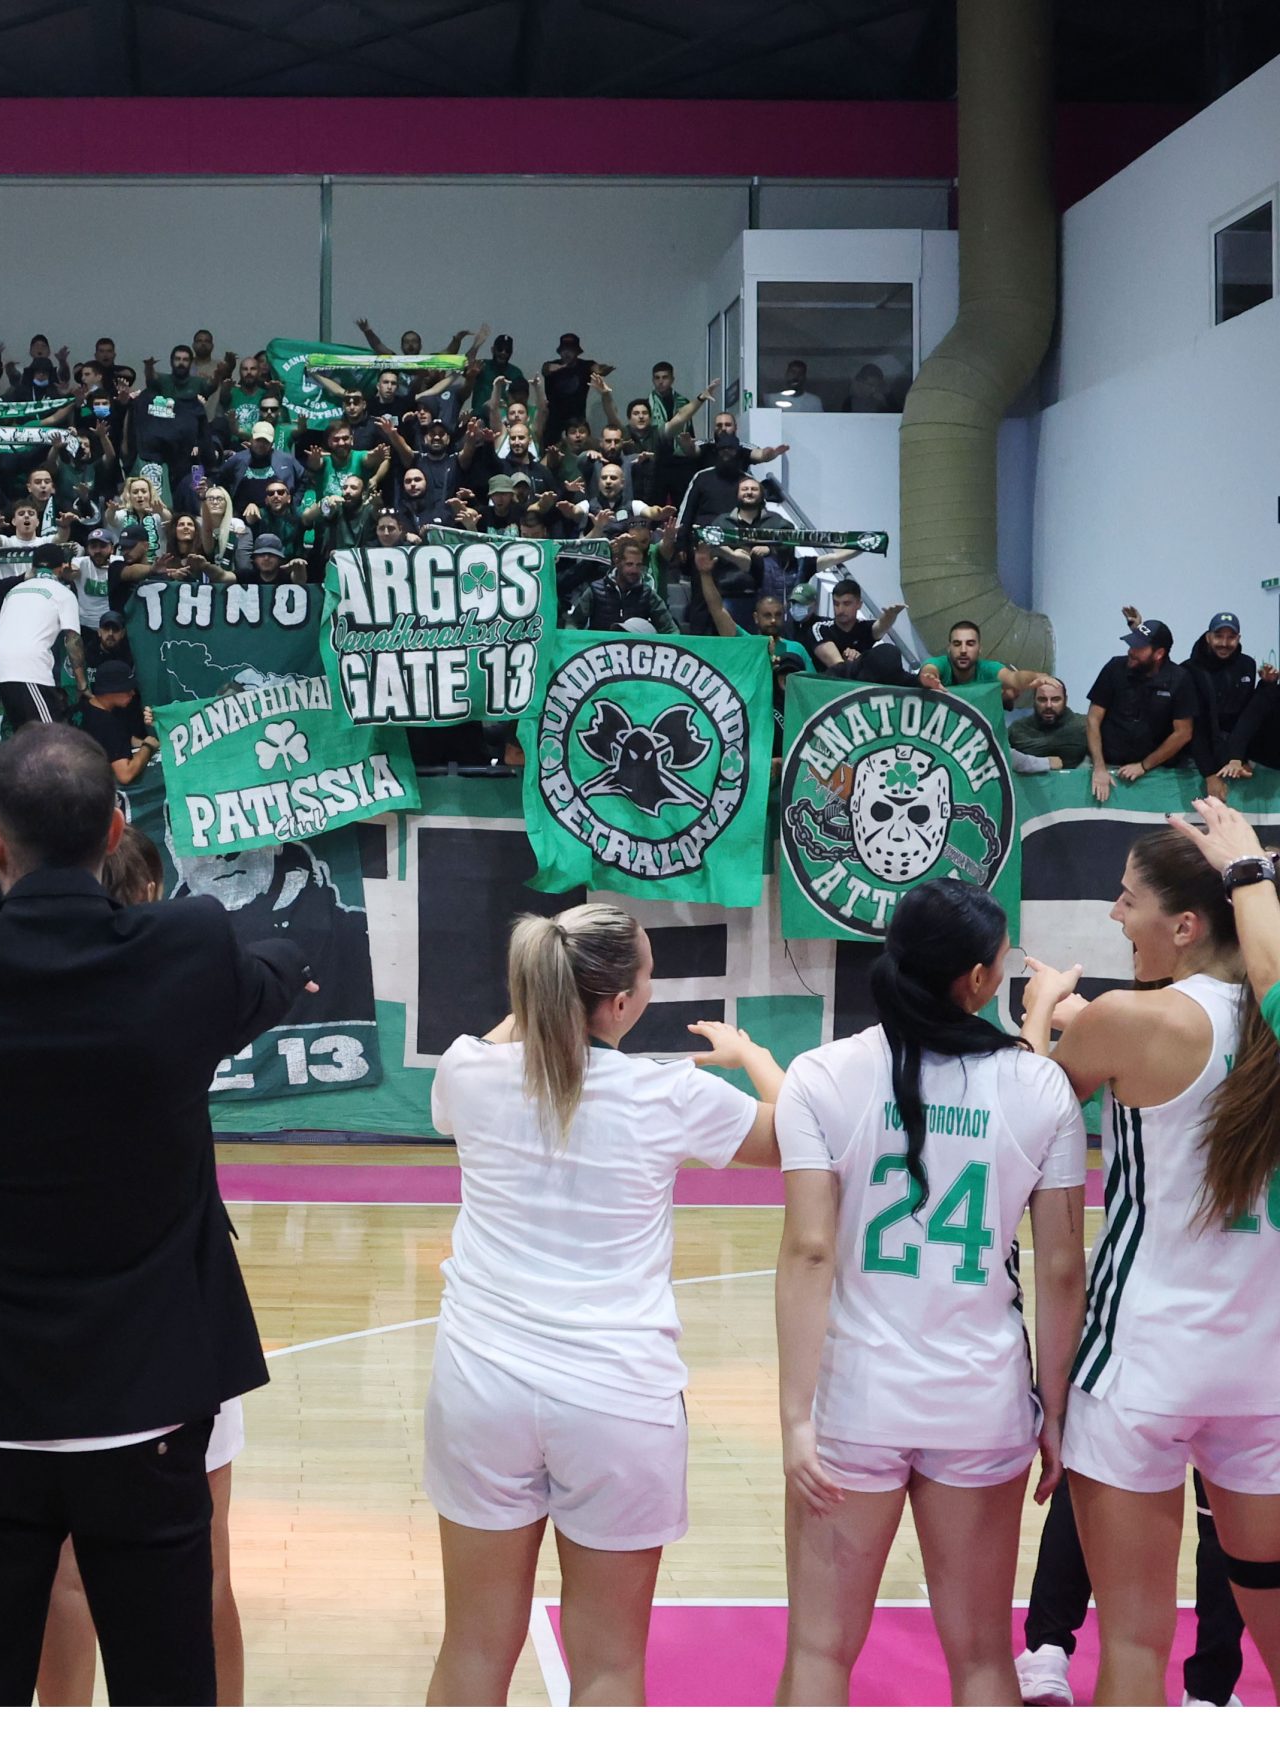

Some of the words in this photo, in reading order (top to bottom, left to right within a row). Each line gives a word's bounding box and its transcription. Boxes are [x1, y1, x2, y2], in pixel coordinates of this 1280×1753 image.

[282, 396, 344, 420] BASKETBAL
[336, 544, 541, 625] ARGOS
[340, 649, 469, 719] GATE
[483, 644, 535, 710] 13
[542, 643, 745, 743] UNDERGROUND
[185, 753, 405, 848] PATISSIA
[540, 770, 742, 876] PETRALONA
[277, 1034, 370, 1085] 13
[884, 1101, 991, 1139] ΥΦΤΟΠΟΥΛΟΥ
[862, 1153, 995, 1286] 24
